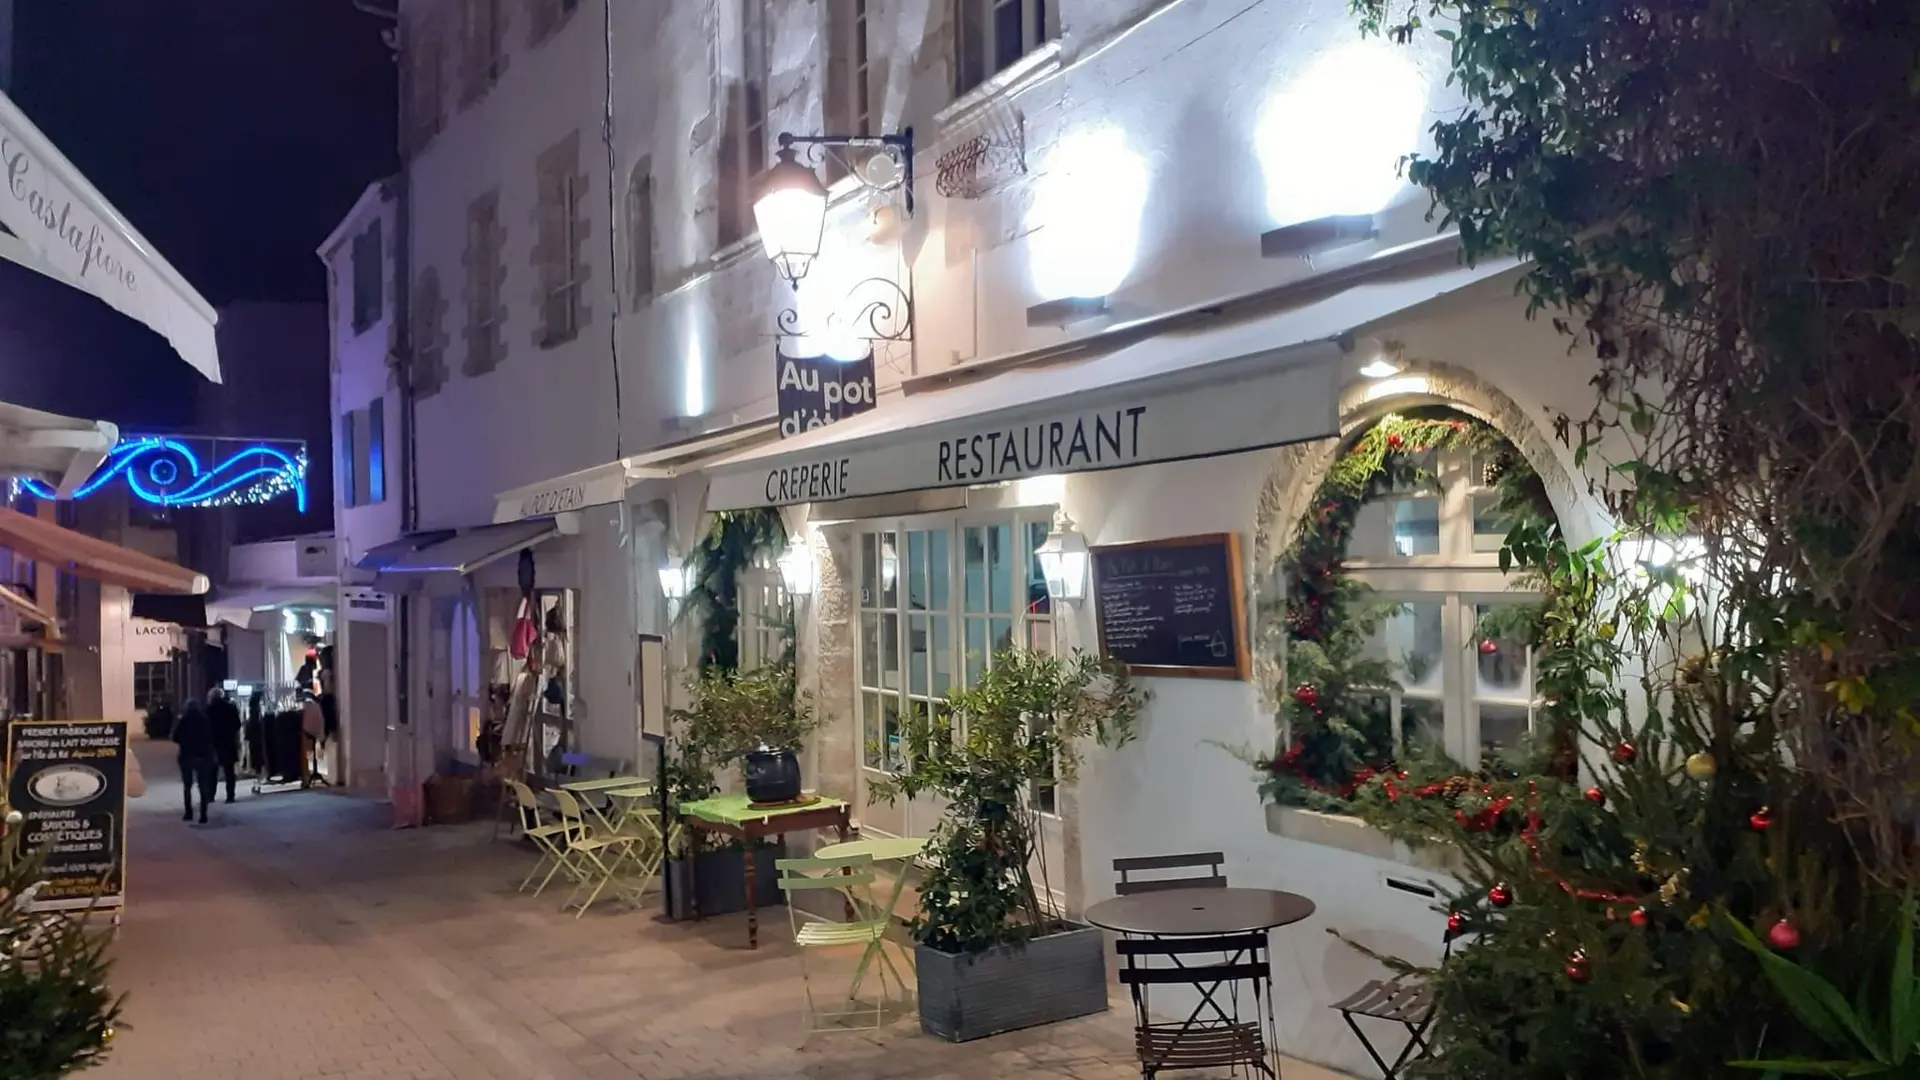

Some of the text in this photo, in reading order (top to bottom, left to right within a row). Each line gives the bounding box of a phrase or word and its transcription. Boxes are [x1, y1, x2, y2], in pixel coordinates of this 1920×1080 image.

[1, 137, 137, 292] Castafiore
[780, 361, 873, 411] Au pot
[938, 406, 1146, 482] RESTAURANT
[765, 458, 850, 503] CREPERIE
